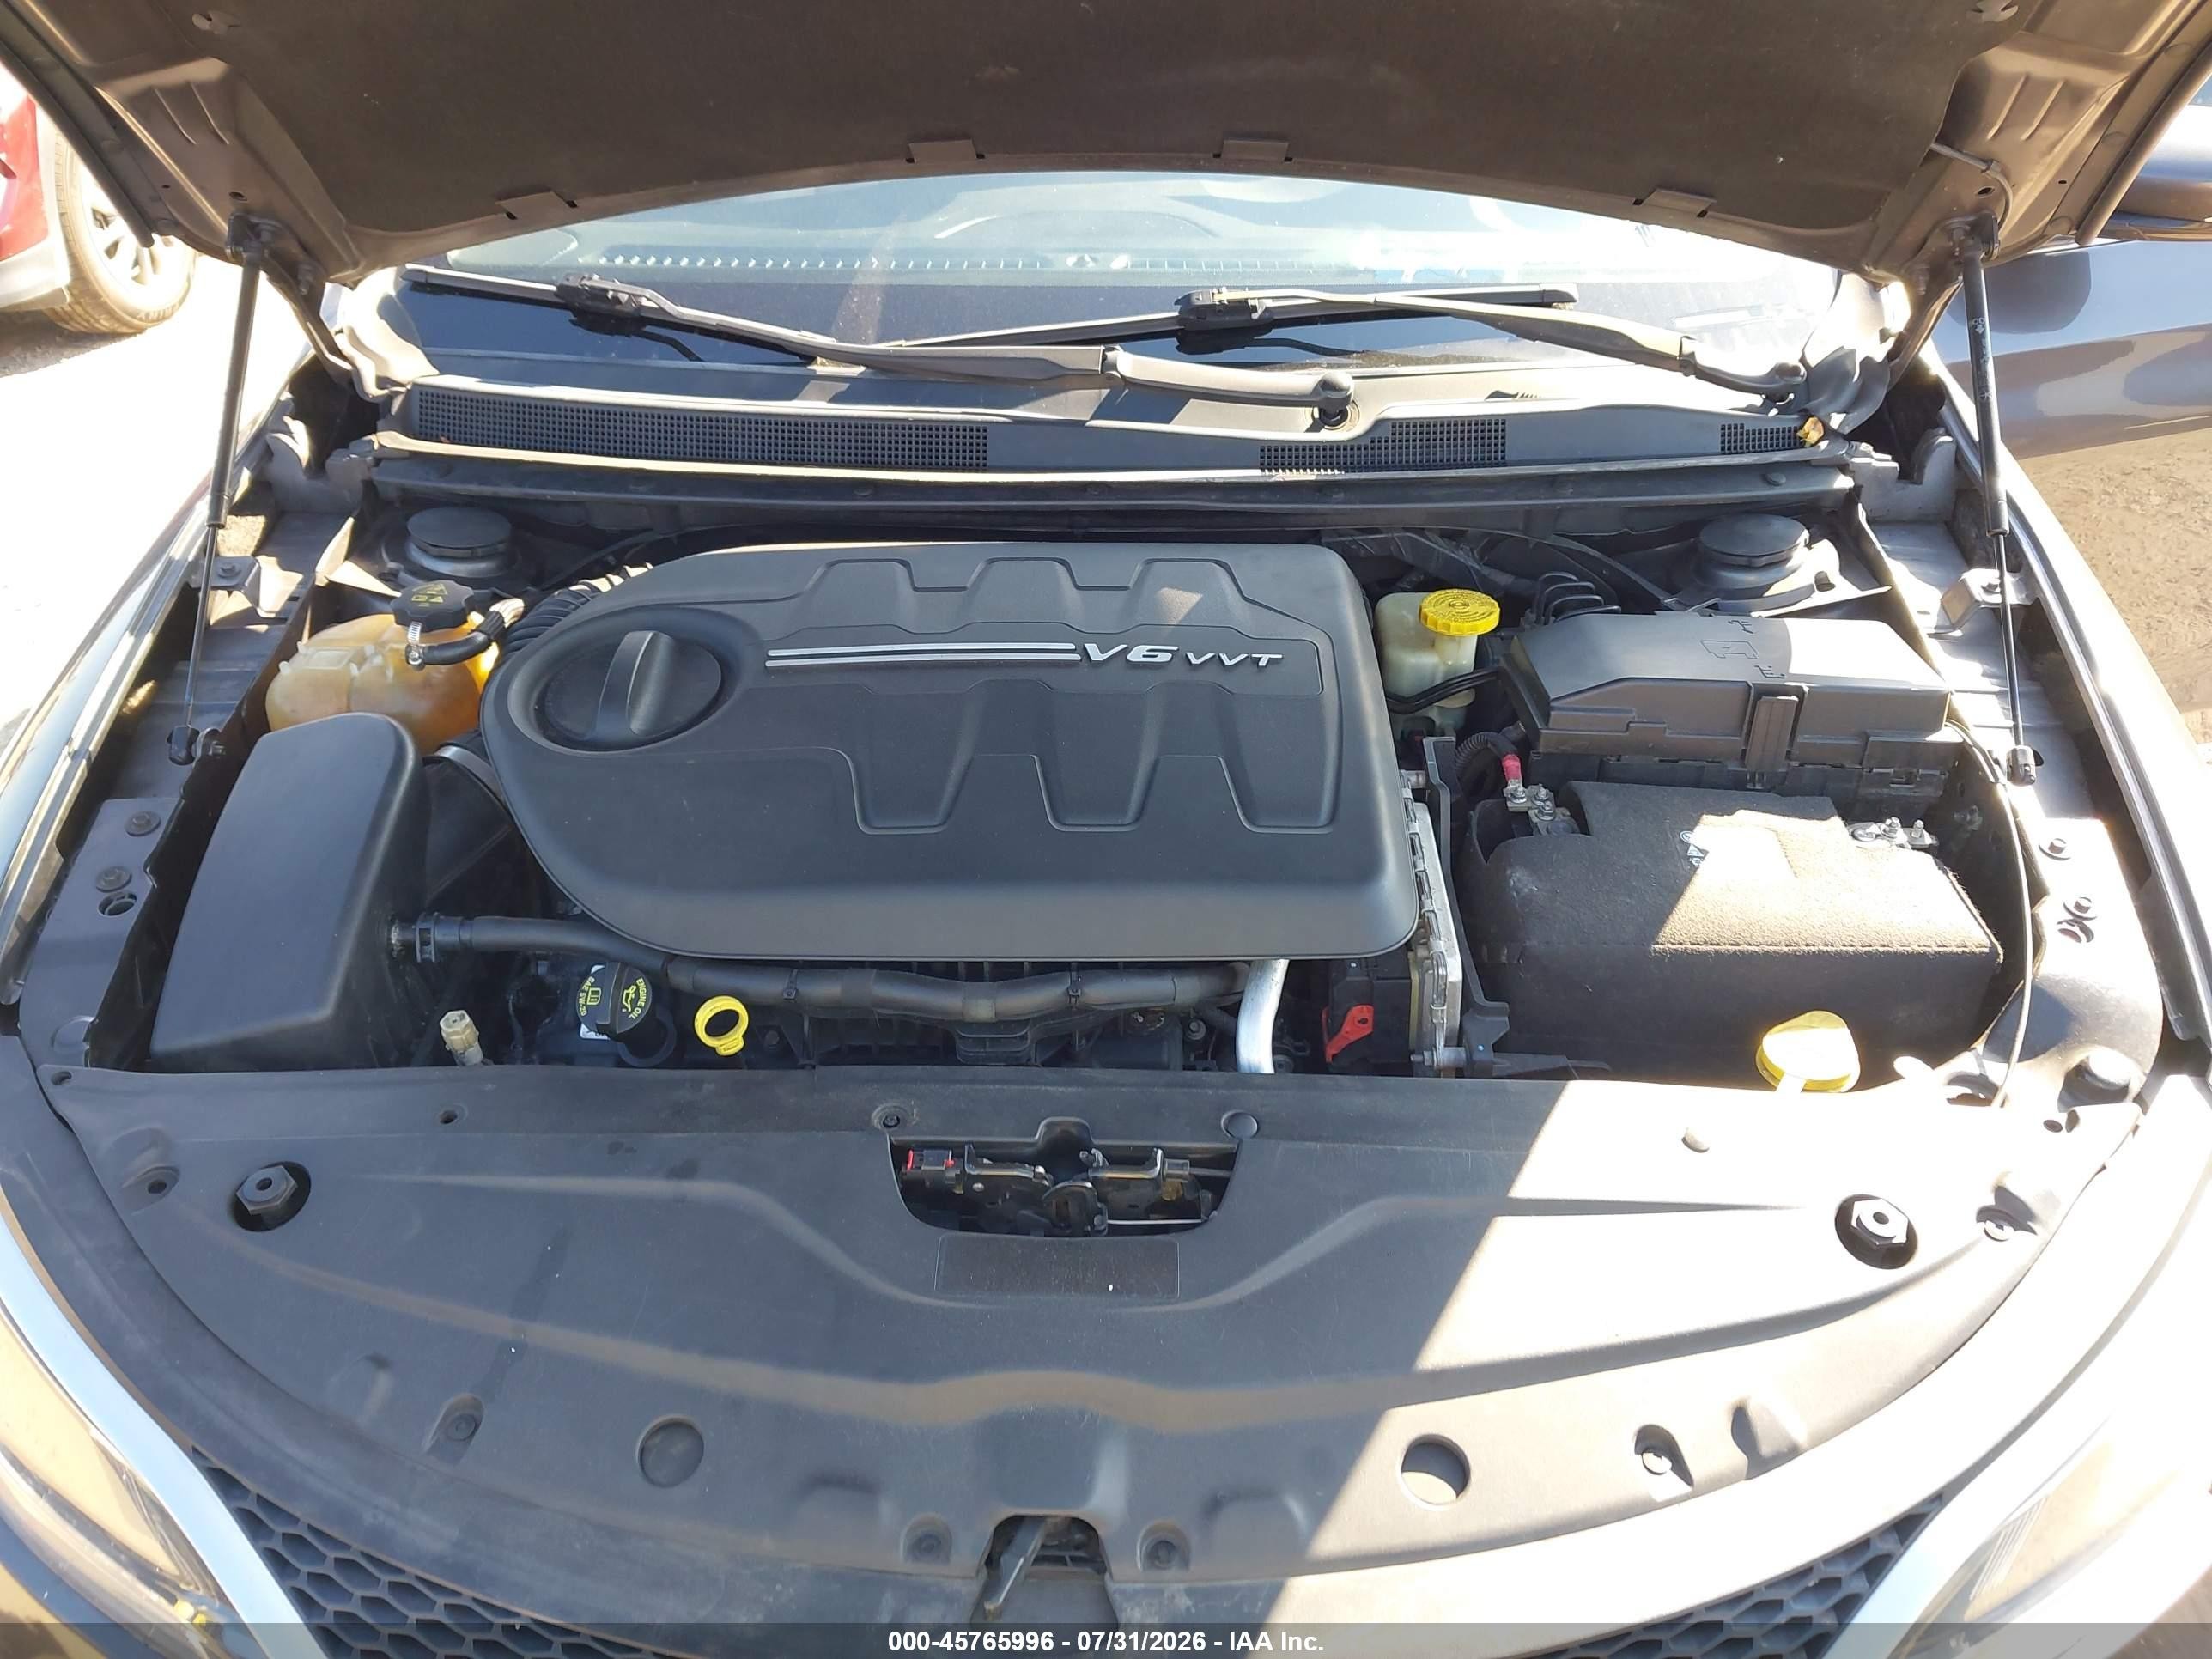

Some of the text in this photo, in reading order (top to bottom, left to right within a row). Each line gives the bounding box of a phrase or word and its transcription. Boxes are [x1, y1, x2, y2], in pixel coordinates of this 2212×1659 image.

[1084, 643, 1284, 667] V6 VVT
[581, 976, 595, 992] SAE
[628, 977, 647, 1020] ENGINE OIL
